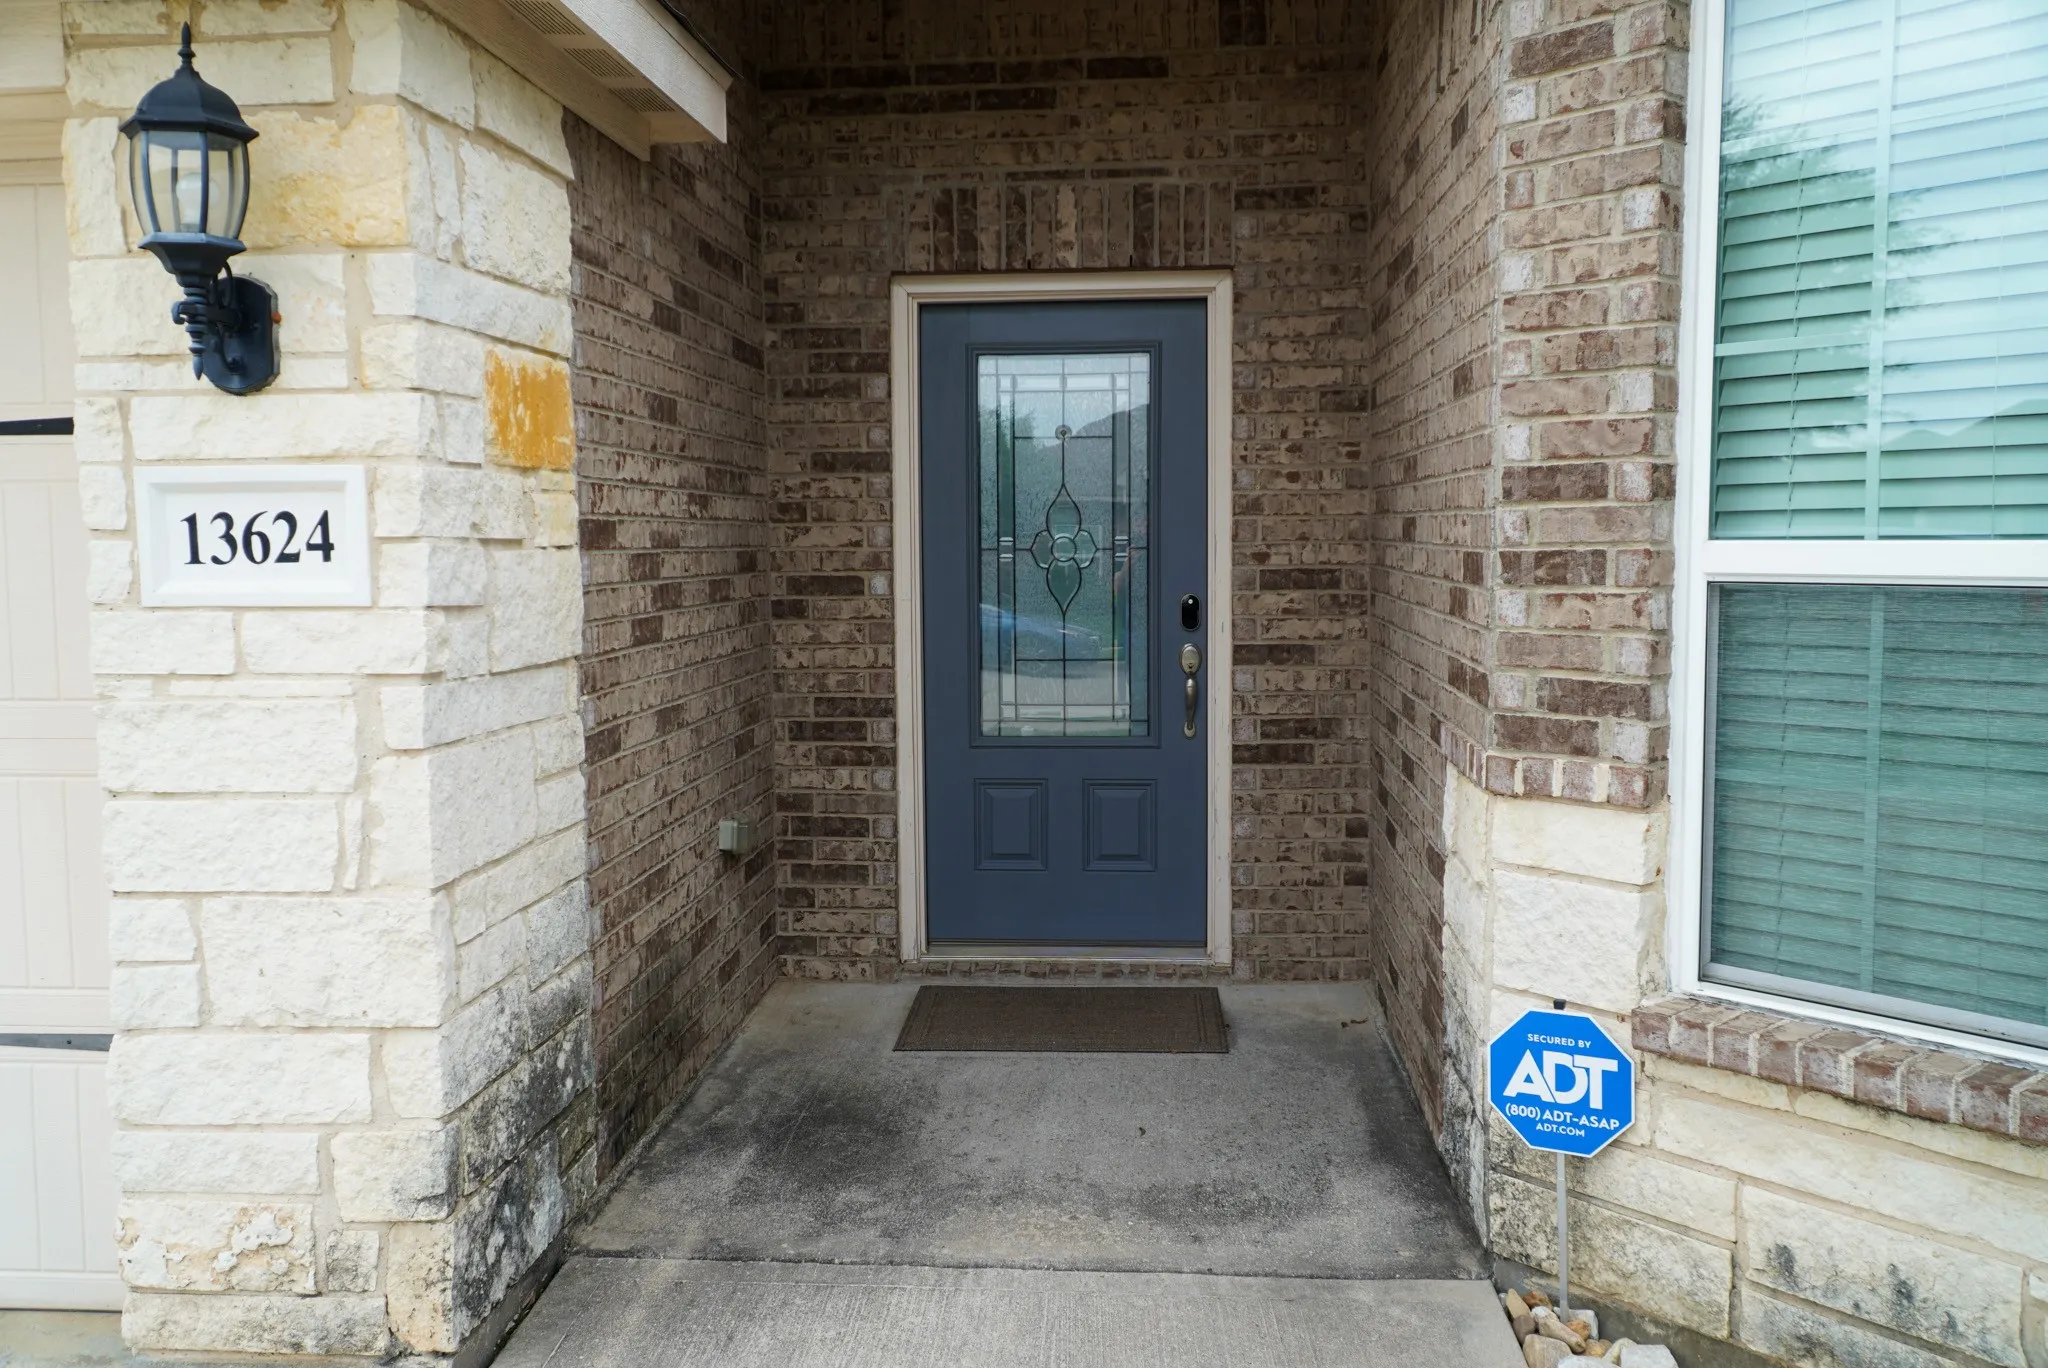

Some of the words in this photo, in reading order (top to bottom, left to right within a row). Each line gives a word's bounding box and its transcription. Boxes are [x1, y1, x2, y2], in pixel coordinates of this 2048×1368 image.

[180, 510, 335, 565] 13624
[1527, 1033, 1575, 1047] SECURED
[1578, 1039, 1592, 1049] BY
[1502, 1049, 1619, 1110] ADT
[1505, 1103, 1541, 1120] (800)
[1542, 1109, 1620, 1131] ADT-ASAP
[1535, 1122, 1586, 1138] ADT.COM
